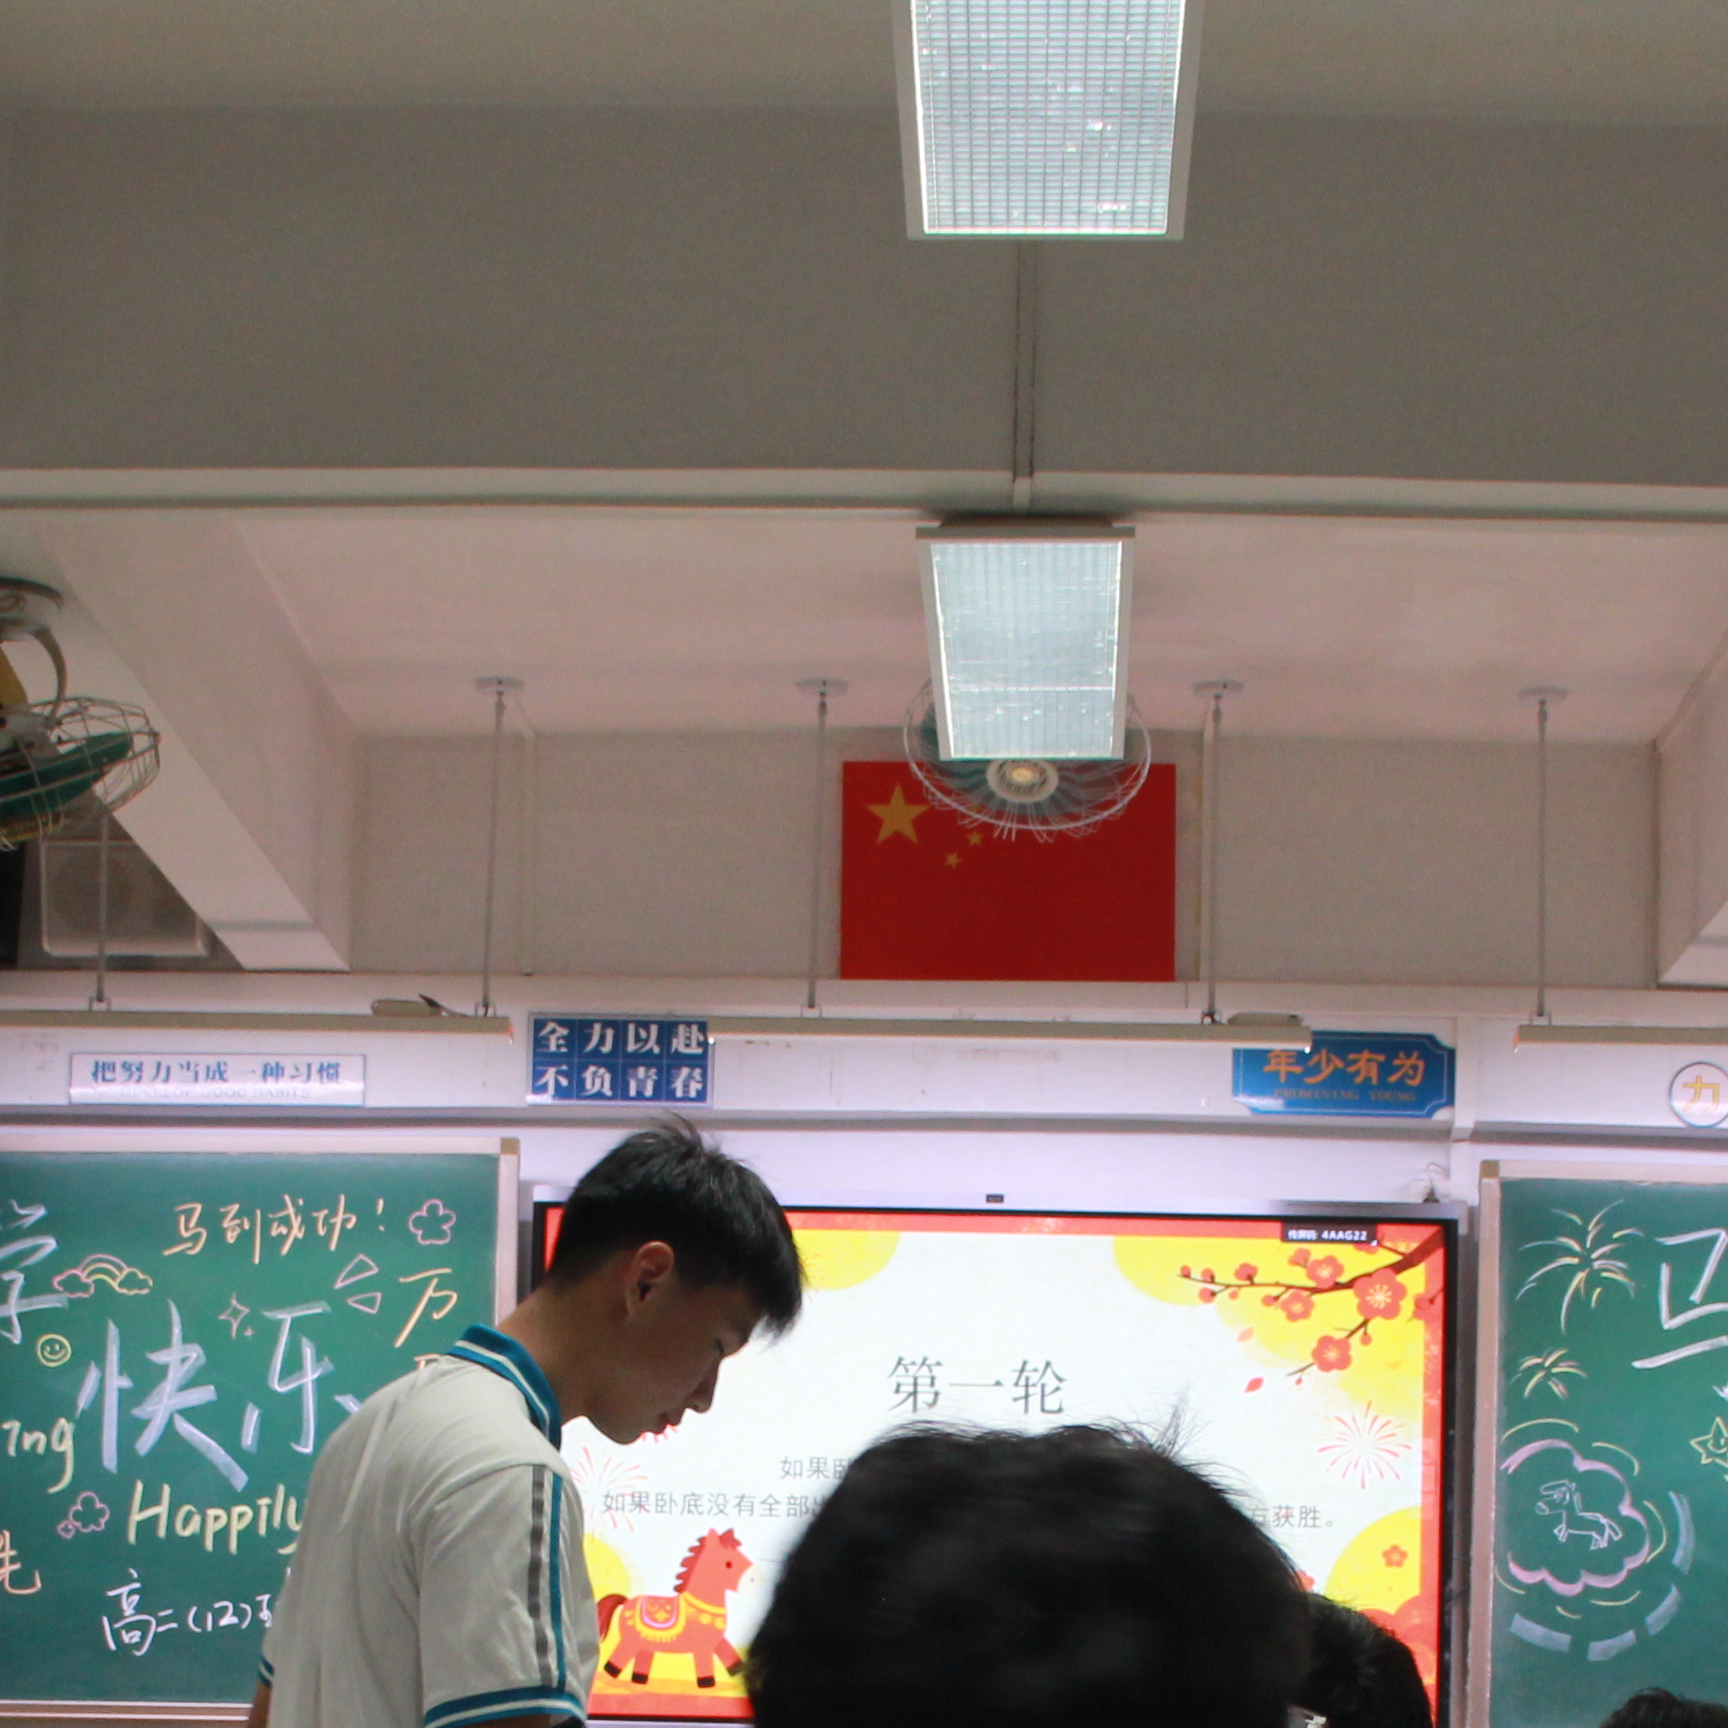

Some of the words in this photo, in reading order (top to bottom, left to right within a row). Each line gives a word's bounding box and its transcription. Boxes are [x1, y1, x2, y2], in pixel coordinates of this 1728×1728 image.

[538, 1021, 704, 1055] 全力以赴
[91, 1060, 342, 1083] 把努力当成一种习惯
[535, 1064, 704, 1098] 不负青春
[1263, 1049, 1426, 1087] 年少有为
[1321, 1230, 1367, 1241] 4AAG22
[72, 1299, 366, 1492] 快乐
[887, 1355, 1067, 1415] 第一轮
[128, 1479, 304, 1556] Happily
